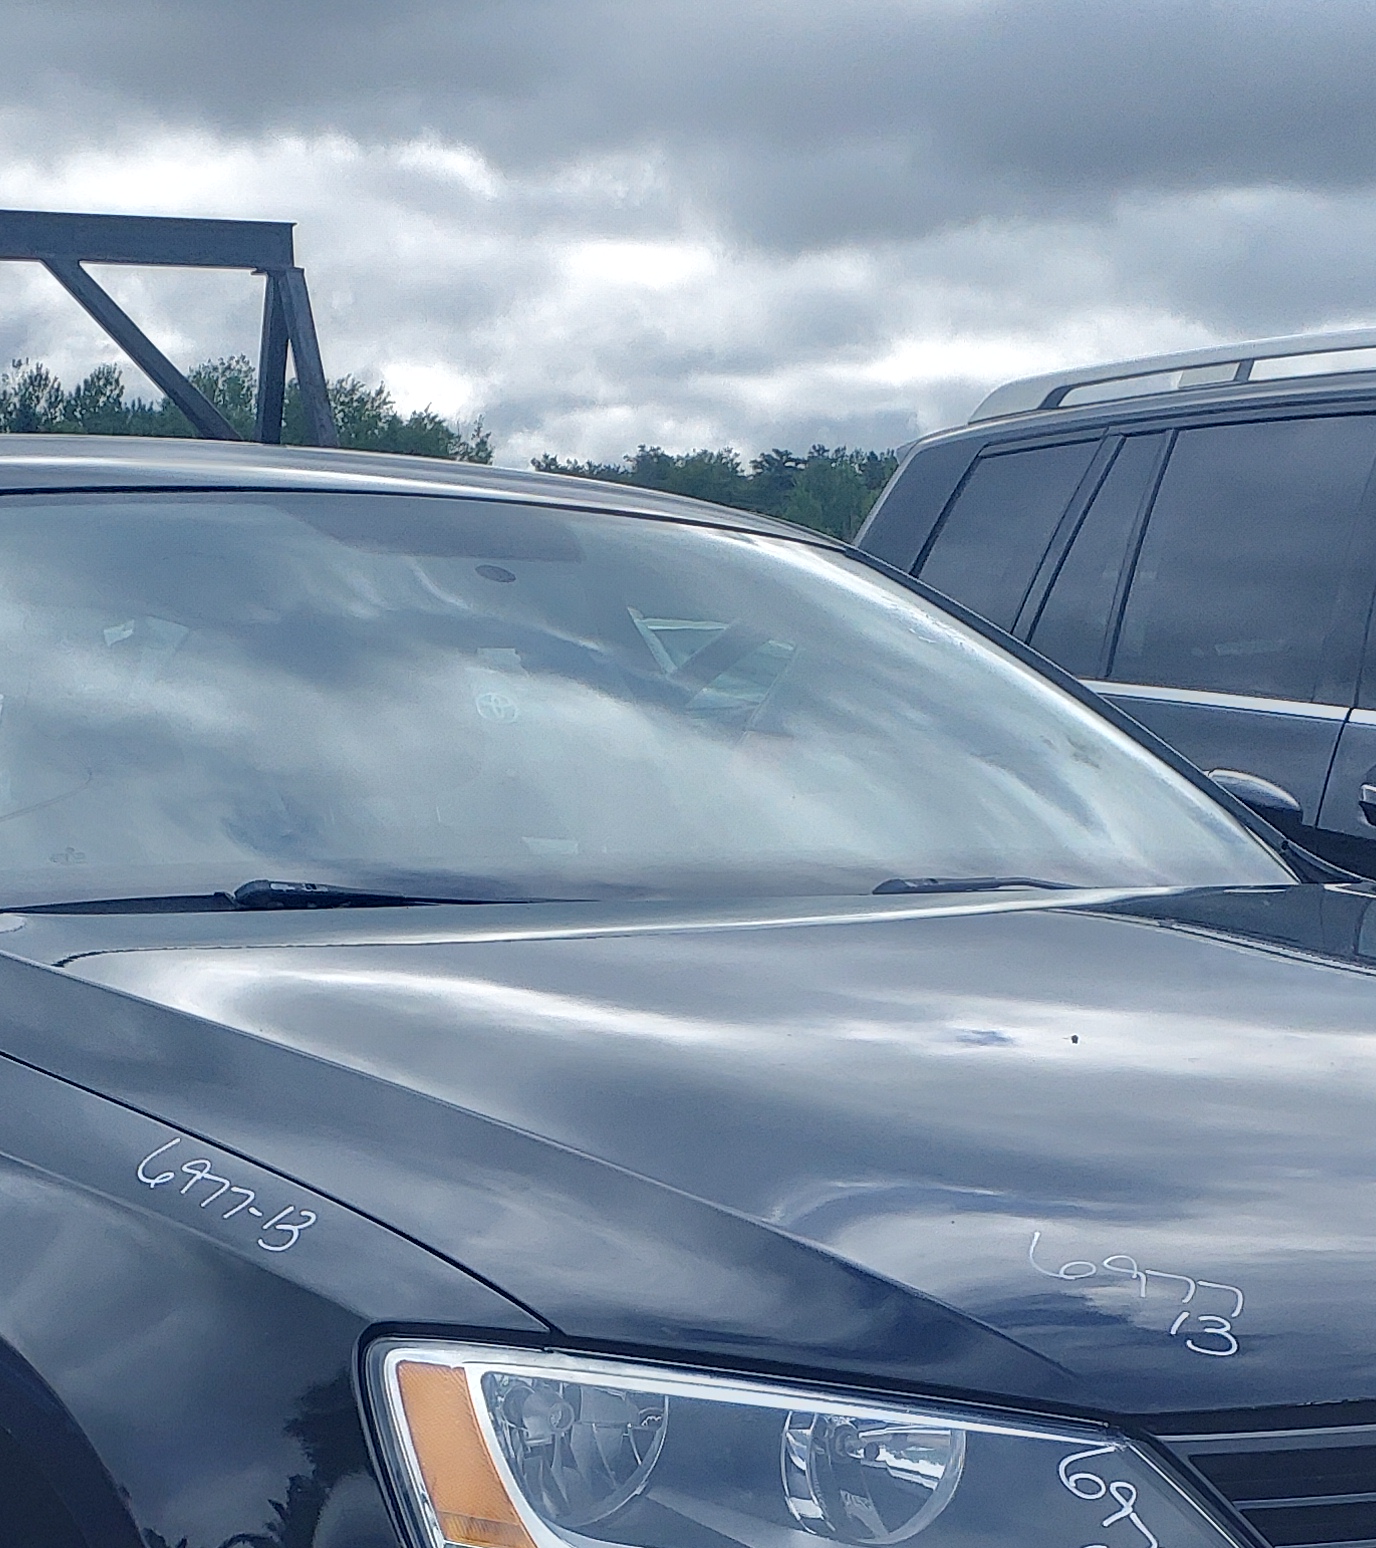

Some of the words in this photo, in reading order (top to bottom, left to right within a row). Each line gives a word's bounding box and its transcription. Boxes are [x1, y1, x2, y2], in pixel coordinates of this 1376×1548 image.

[137, 1137, 317, 1252] 6977-13
[1029, 1231, 1245, 1318] 6977
[1169, 1311, 1240, 1357] 13
